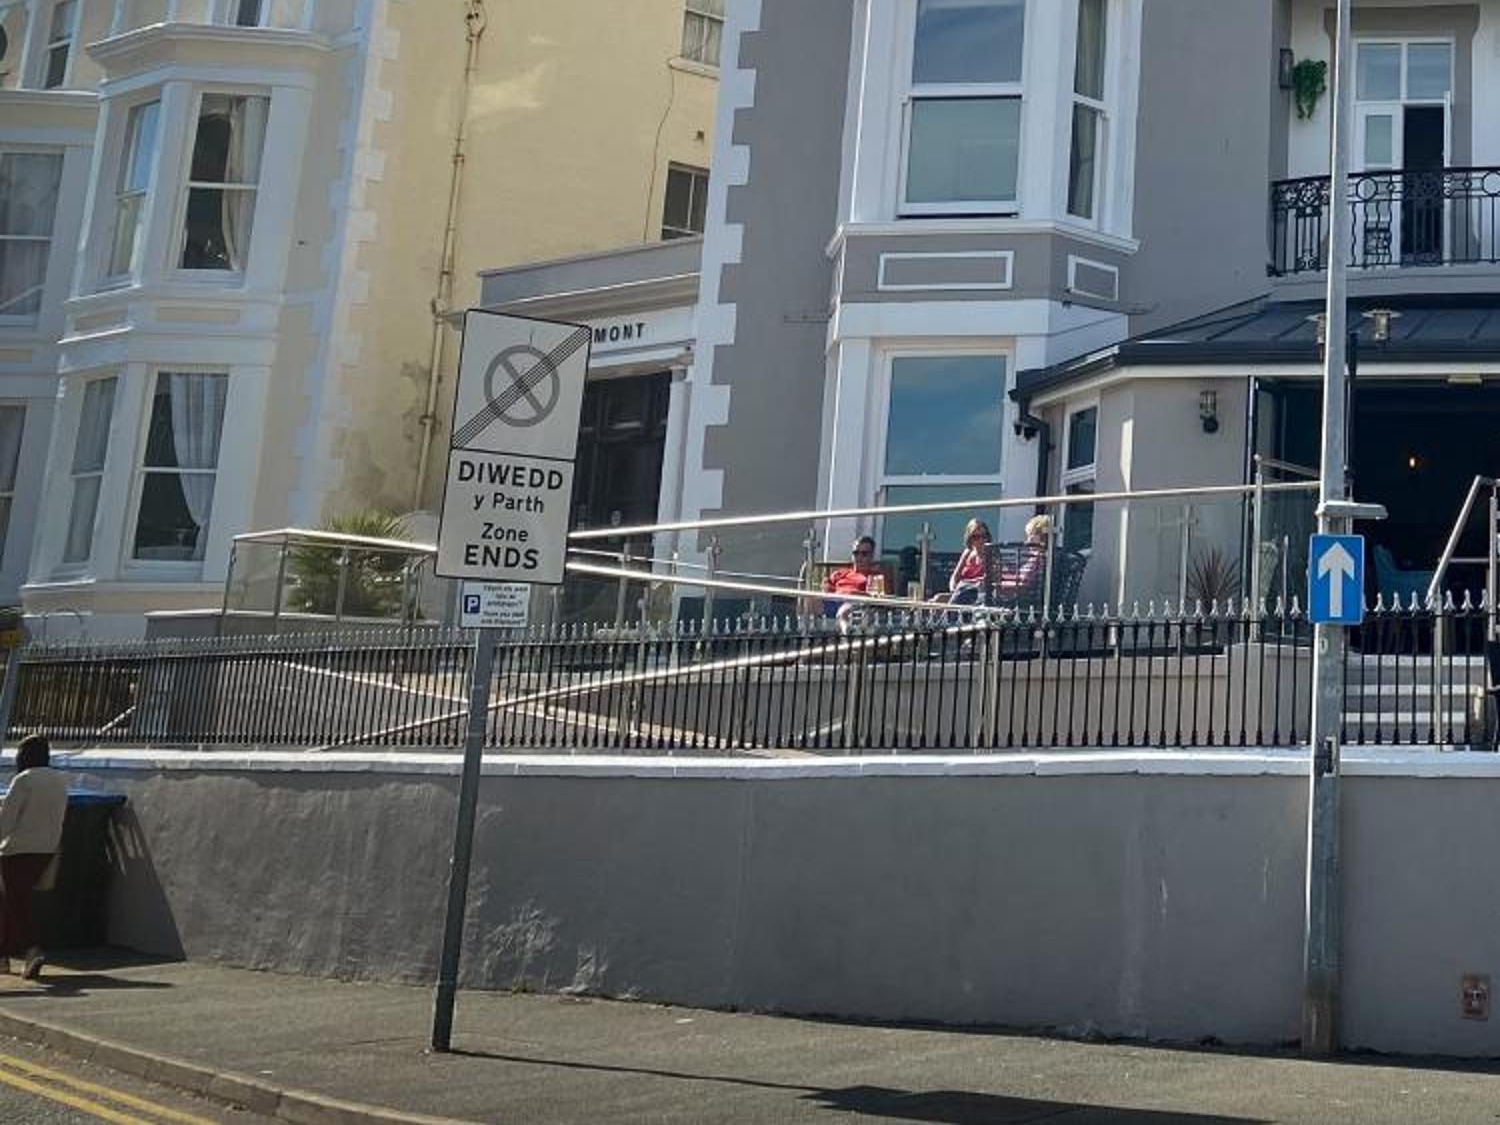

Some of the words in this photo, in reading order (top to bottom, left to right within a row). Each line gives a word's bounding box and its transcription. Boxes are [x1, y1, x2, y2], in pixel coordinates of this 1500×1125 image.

[593, 322, 645, 343] MONT
[458, 461, 563, 489] DIWEDD
[474, 493, 483, 509] y
[493, 493, 544, 513] Parth
[481, 523, 528, 542] Zone
[464, 545, 539, 569] ENDS
[466, 595, 479, 612] P
